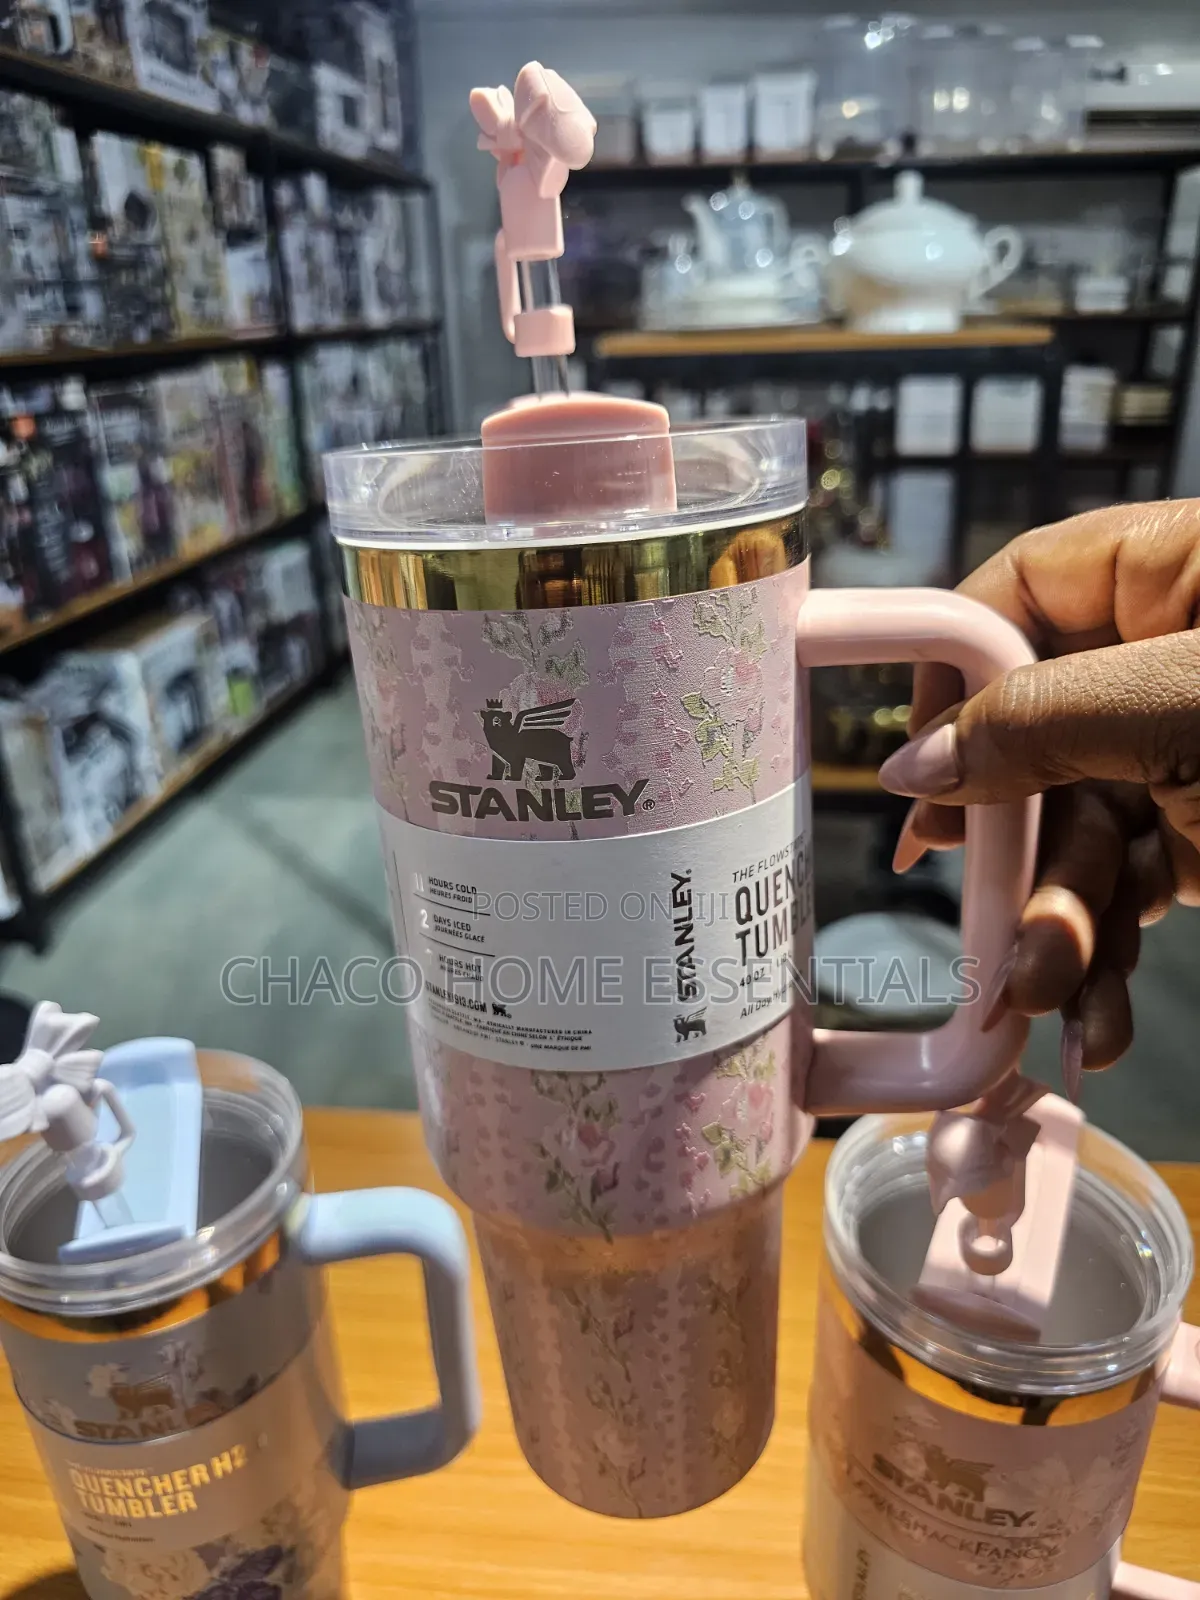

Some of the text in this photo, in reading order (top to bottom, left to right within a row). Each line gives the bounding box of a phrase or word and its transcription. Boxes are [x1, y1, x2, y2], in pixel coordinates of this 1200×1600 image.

[732, 864, 755, 883] THE
[428, 876, 454, 891] HOURS
[455, 883, 477, 895] COLD
[429, 887, 473, 904] HEURES FROID
[420, 908, 472, 932] 2 DAYS ICED
[434, 925, 463, 939] JOURNÉES
[739, 974, 752, 987] 40
[753, 966, 766, 981] OZ
[740, 997, 772, 1019] All Day
[68, 1462, 211, 1499] QUENCHER
[72, 1486, 198, 1519] TUMBLER
